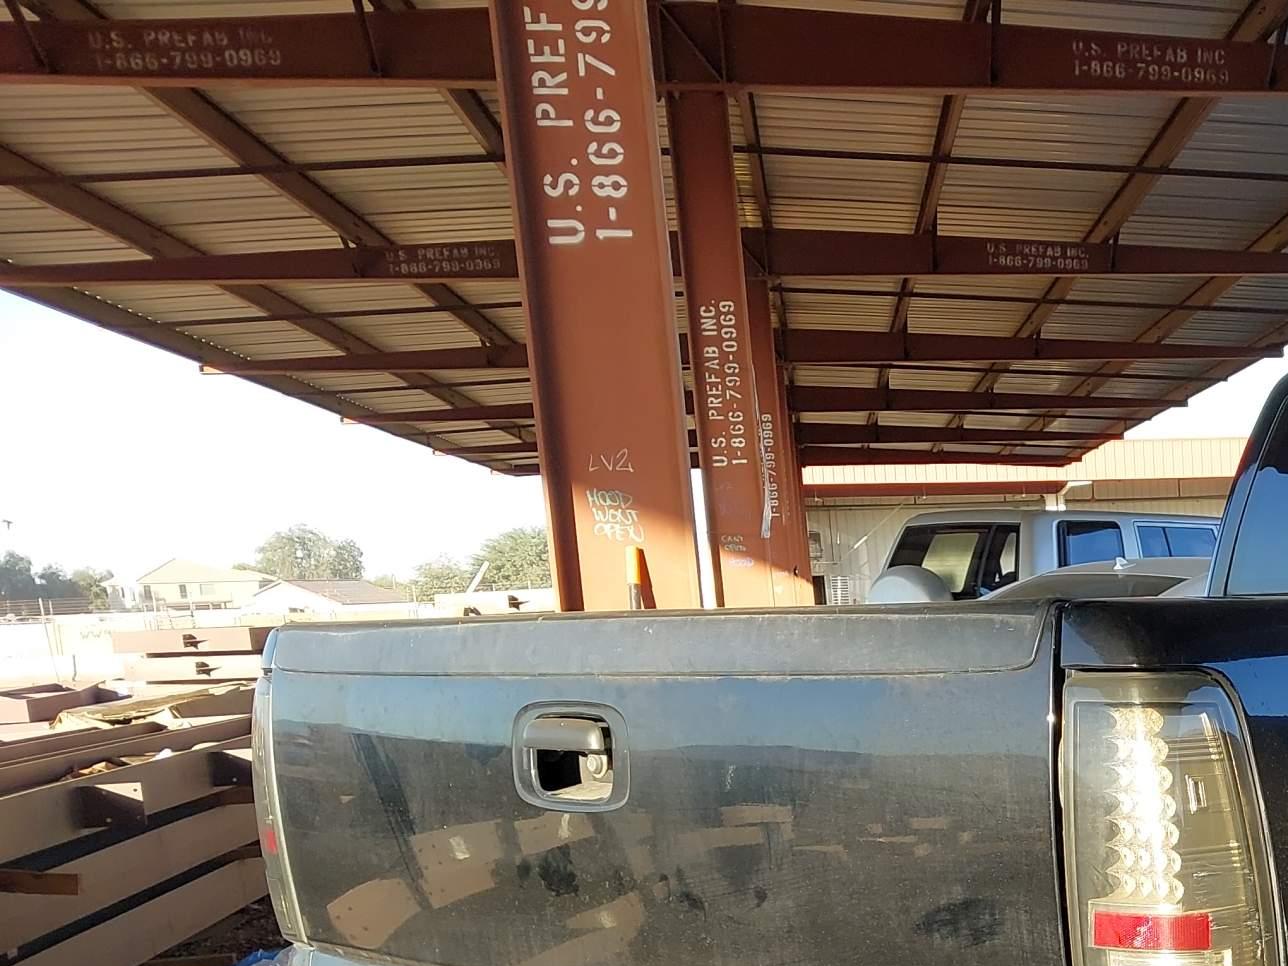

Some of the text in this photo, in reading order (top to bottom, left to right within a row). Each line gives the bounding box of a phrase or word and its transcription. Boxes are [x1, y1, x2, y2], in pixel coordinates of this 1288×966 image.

[144, 31, 228, 47] PREFAB
[1117, 42, 1188, 63] PREFAB
[1074, 60, 1229, 85] 1-866-799-0969
[543, 157, 585, 244] U.S.
[988, 255, 1089, 270] 1-866-799-0969
[1015, 244, 1062, 257] PREFAB
[700, 300, 718, 336] INC.
[704, 346, 725, 420] PREFAB
[719, 300, 748, 465] 1-866-799-0969
[711, 431, 728, 467] U.S.
